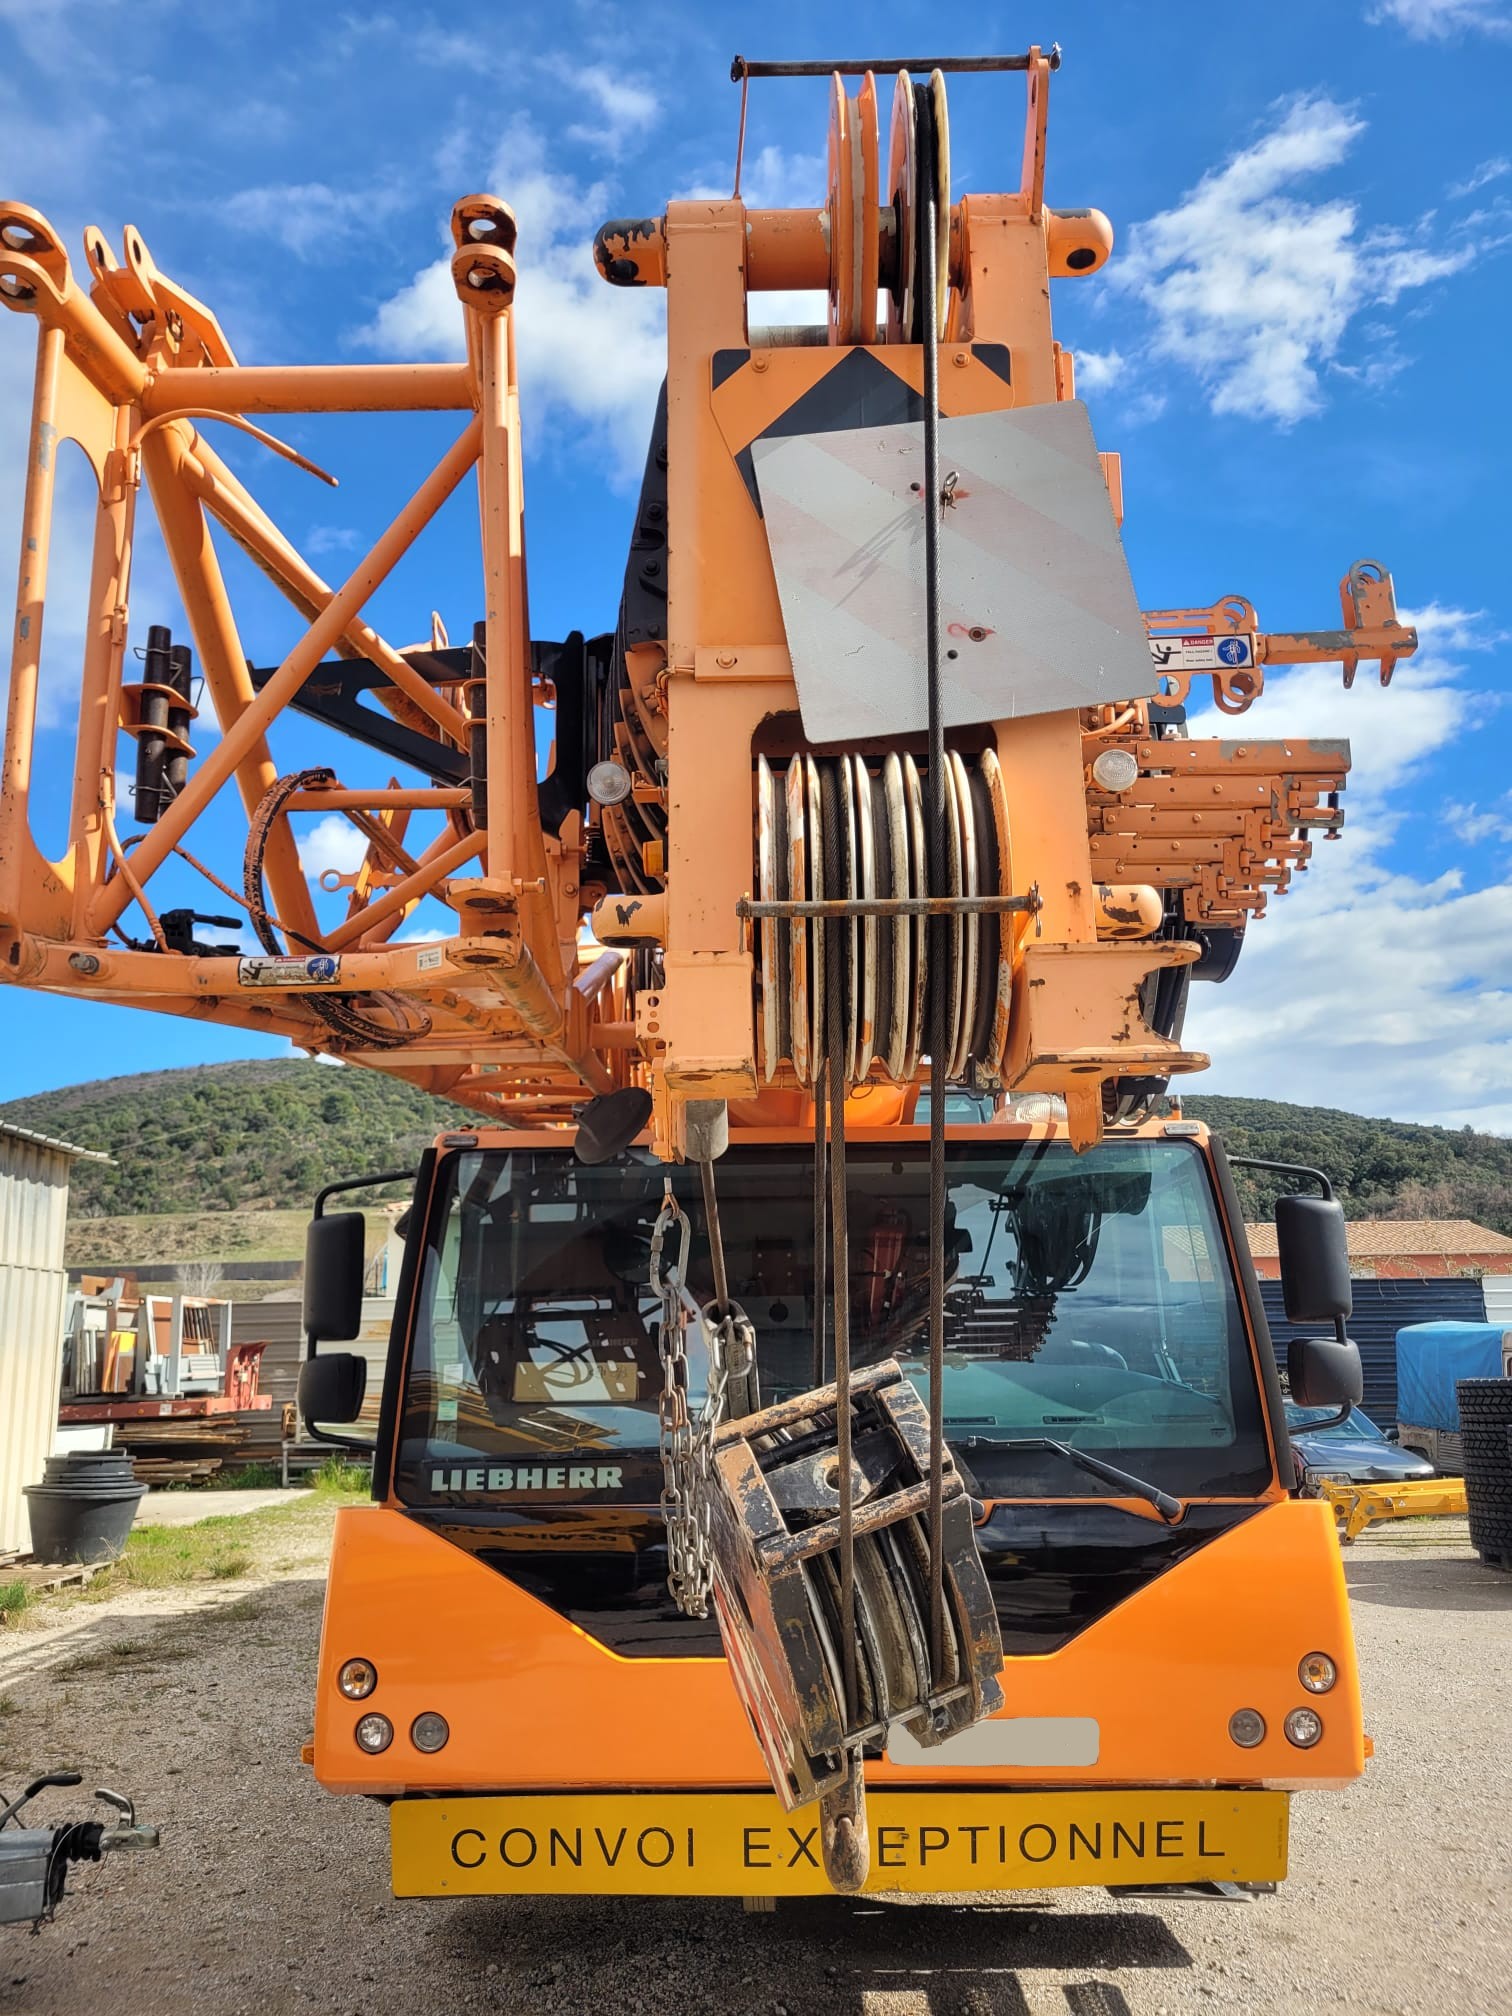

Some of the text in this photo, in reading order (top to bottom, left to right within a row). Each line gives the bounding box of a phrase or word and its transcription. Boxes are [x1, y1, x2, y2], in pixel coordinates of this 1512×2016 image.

[431, 1467, 624, 1491] LIEBHERR
[451, 1826, 694, 1868] CONVOI
[743, 1820, 1226, 1868] EXEPTIONNEL
